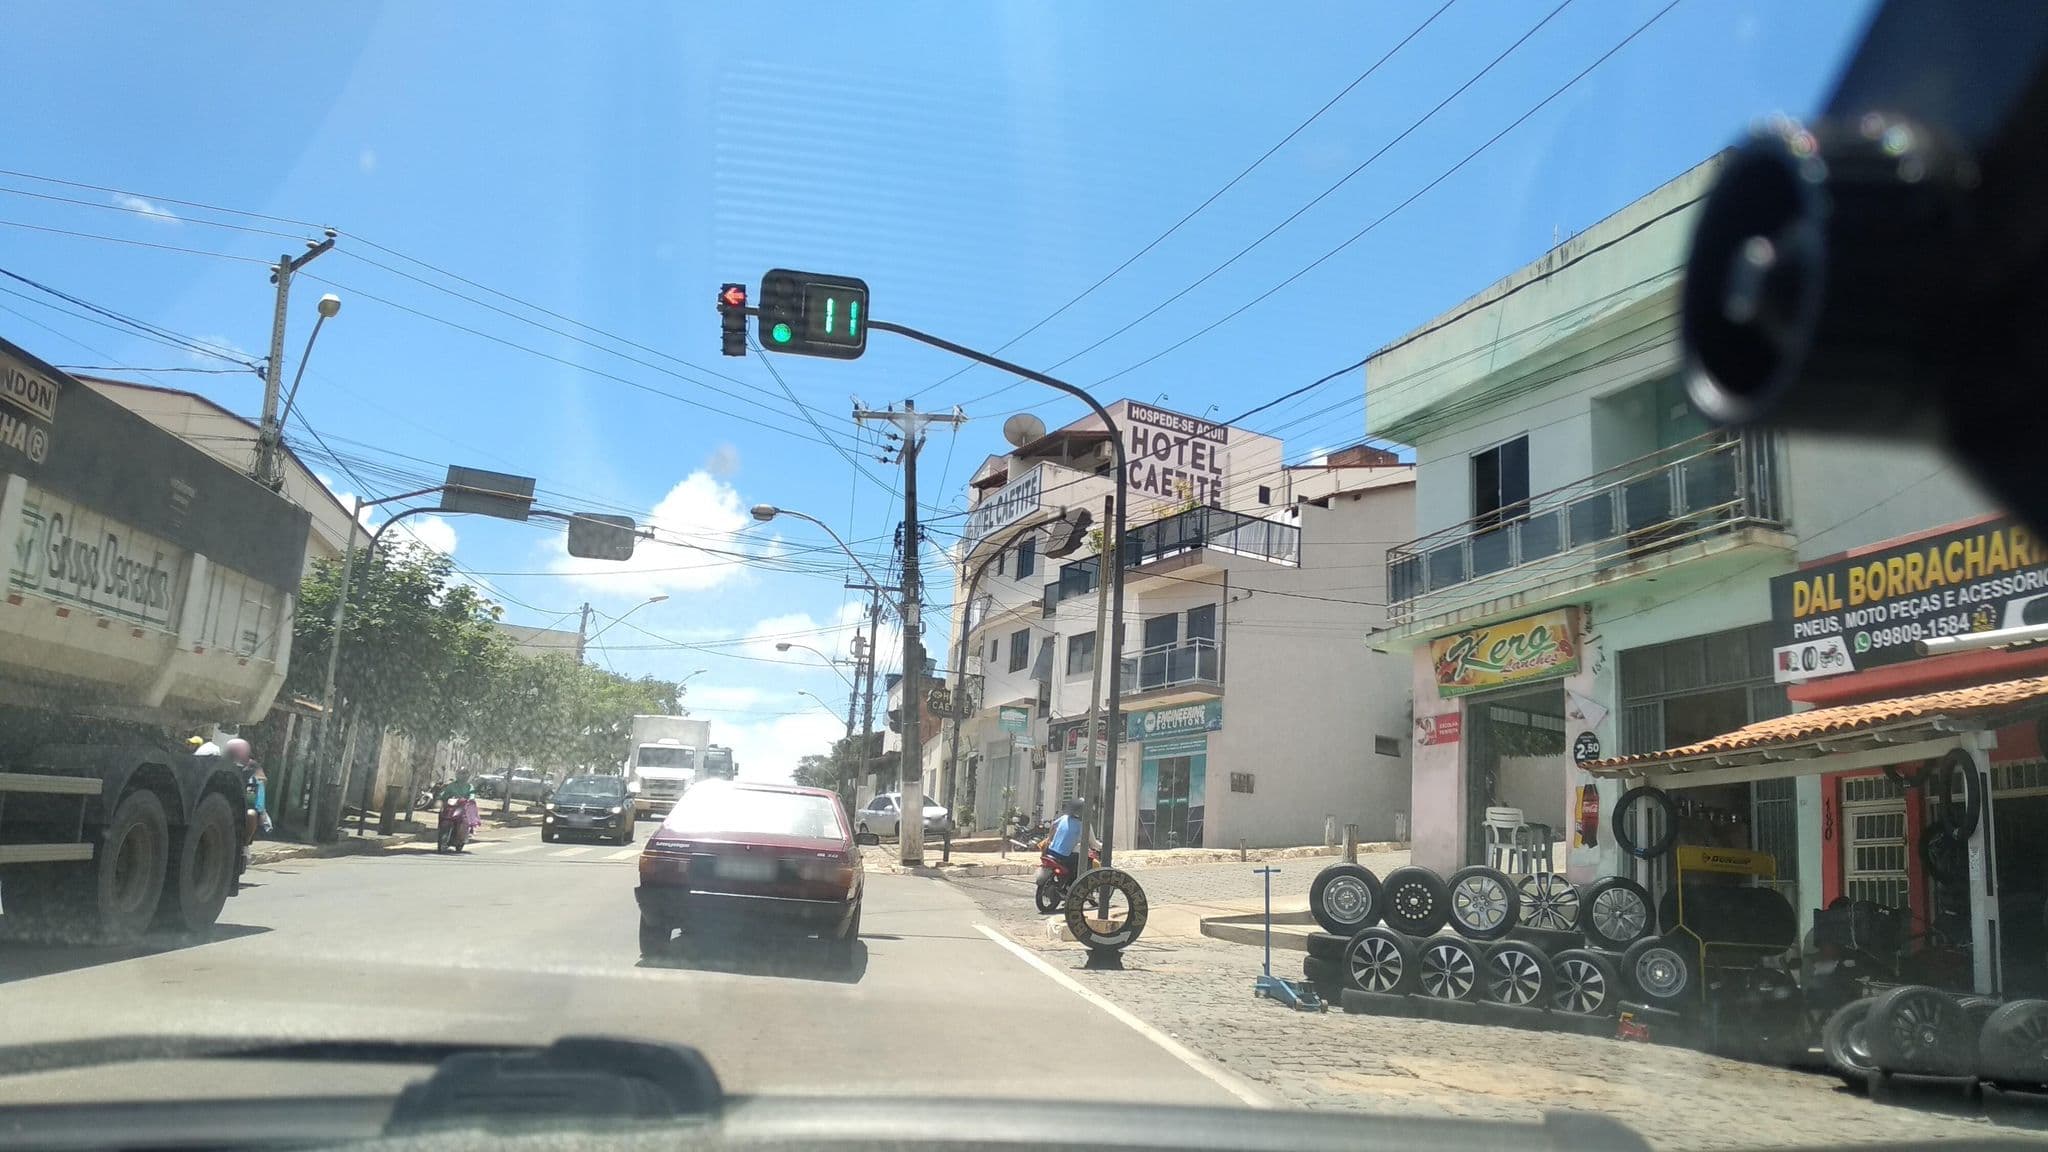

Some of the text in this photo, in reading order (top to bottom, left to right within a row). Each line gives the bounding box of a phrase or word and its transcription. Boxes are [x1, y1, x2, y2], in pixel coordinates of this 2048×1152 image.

[1131, 405, 1195, 434] HOSPEDE-SE
[1131, 425, 1223, 475] HOTEL
[1129, 460, 1223, 510] CAETITÉ
[1793, 573, 1843, 618] DAL
[1793, 615, 1843, 639] PNEUS,
[1845, 605, 1887, 629] MOTO
[1889, 593, 1942, 620] PEÇAS
[1944, 590, 1957, 608] E
[1871, 611, 1971, 649] 99809-1584
[1576, 743, 1599, 759] 2,50
